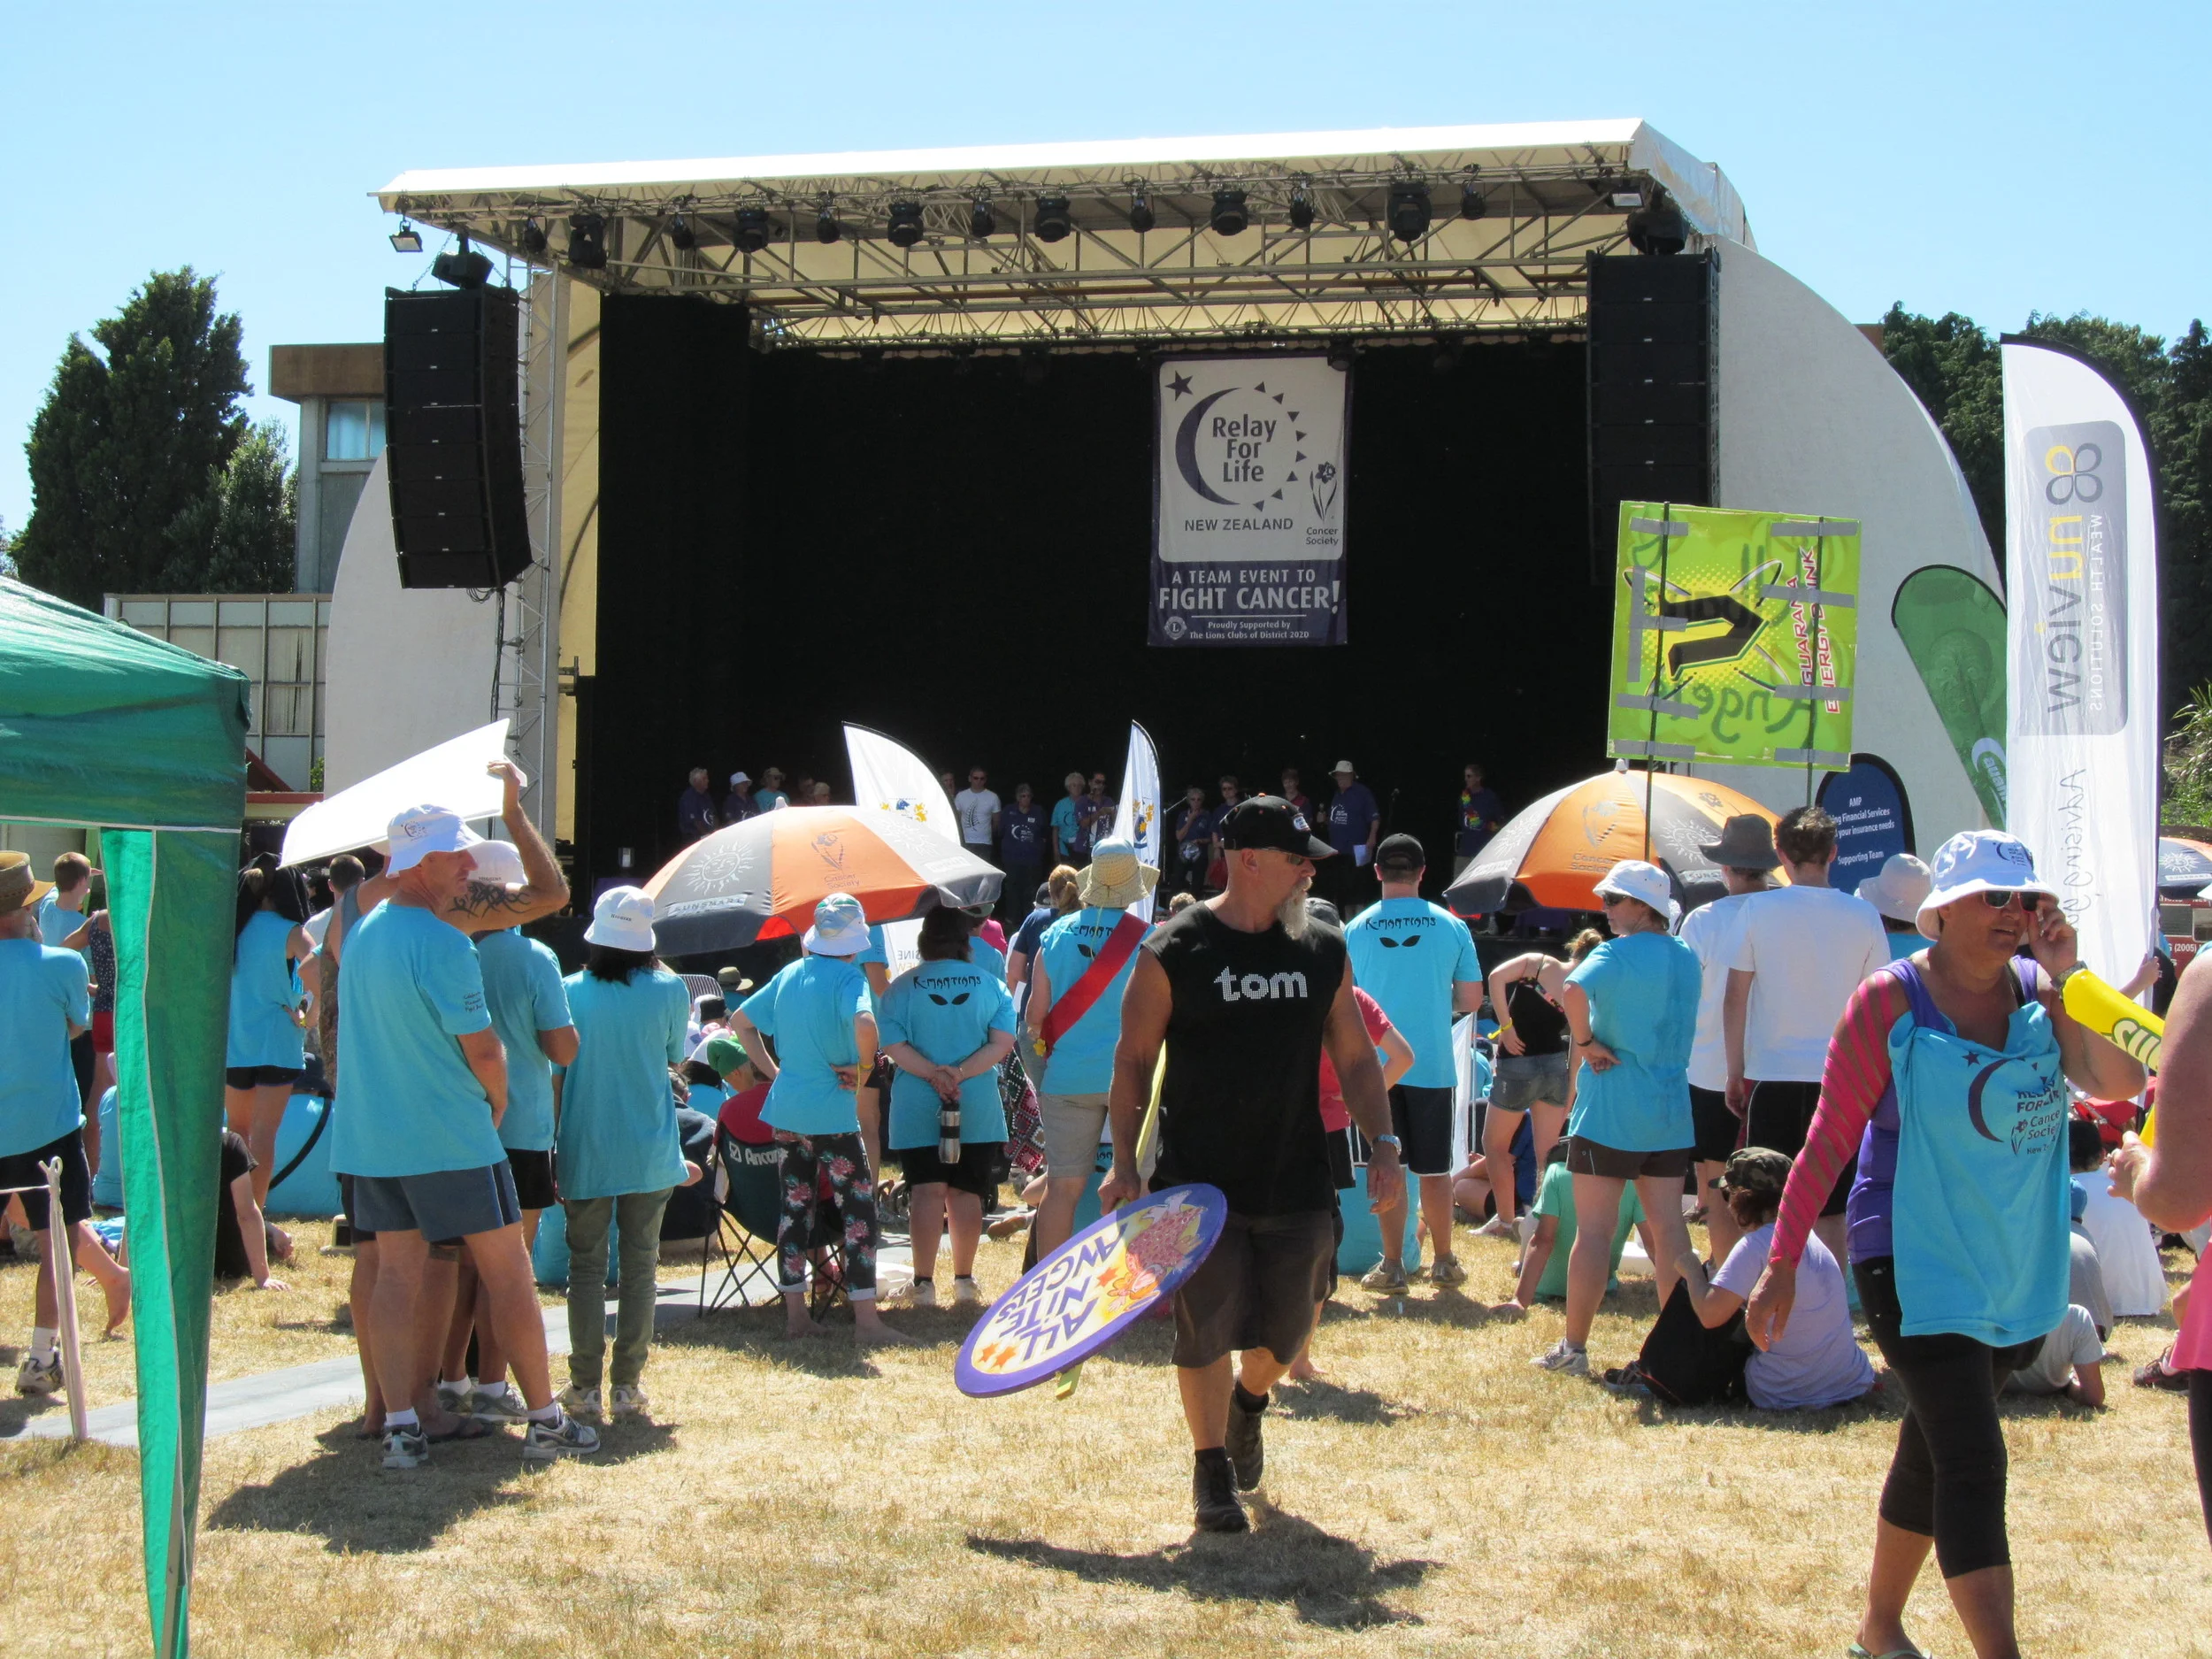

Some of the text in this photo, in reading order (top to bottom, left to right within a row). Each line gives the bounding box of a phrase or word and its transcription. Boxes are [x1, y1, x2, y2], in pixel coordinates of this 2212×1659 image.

[1212, 413, 1277, 443] Relay
[1226, 441, 1262, 459] For
[1223, 459, 1264, 483] Life
[1185, 518, 1294, 532] NEW ZEALAND
[1306, 526, 1339, 536] Cancer
[1306, 535, 1339, 546] Society
[1171, 569, 1316, 584] A TEAM EVENT TO
[1159, 580, 1341, 614] FIGHT CANCER!
[1208, 620, 1291, 630] Proudly Supported by
[1260, 630, 1287, 639] District
[1848, 796, 1863, 807] AMP
[1842, 809, 1867, 822] Financial
[1867, 807, 1891, 818] Services
[1838, 828, 1852, 839] your
[1851, 826, 1878, 835] insurance
[1878, 819, 1895, 830] needs
[1838, 850, 1885, 865] Supporting Team
[1213, 965, 1308, 1002] tom
[2030, 1110, 2060, 1127] Cance
[997, 1222, 1129, 1323] ANGELS
[1018, 1297, 1098, 1362] ALL
